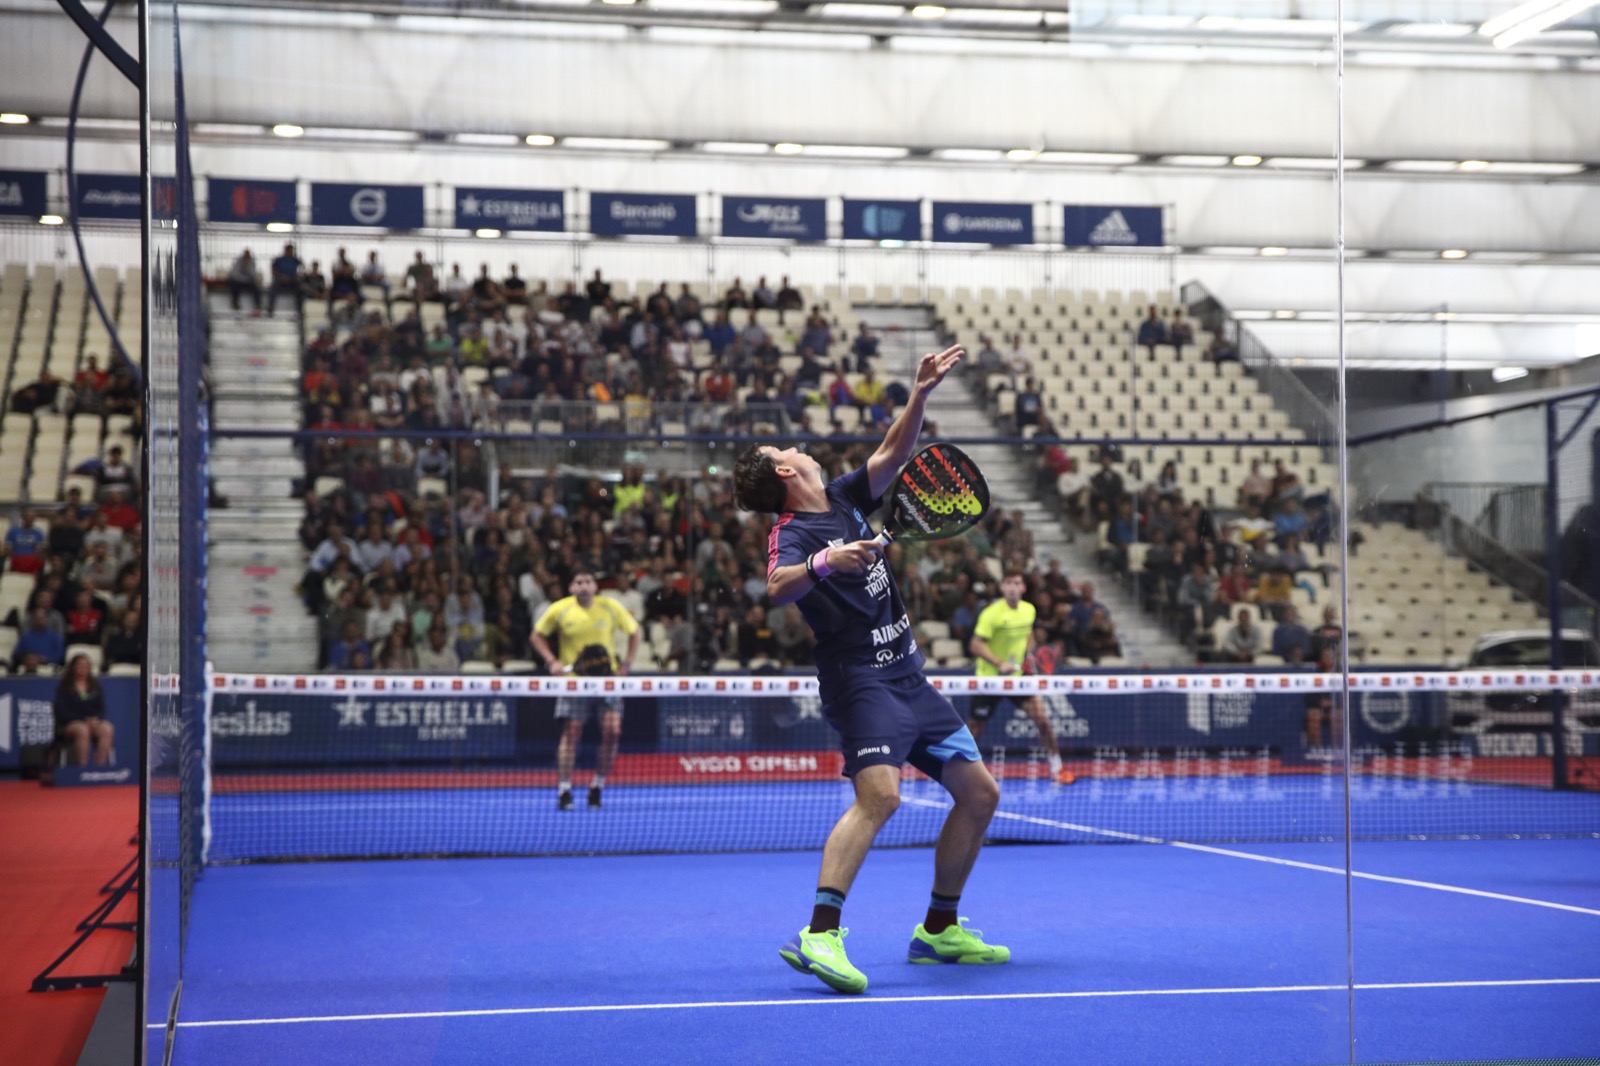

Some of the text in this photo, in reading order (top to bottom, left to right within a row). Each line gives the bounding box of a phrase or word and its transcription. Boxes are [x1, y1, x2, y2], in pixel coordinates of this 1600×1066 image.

[482, 200, 561, 218] ESTRELLA
[898, 493, 935, 534] Bullpadel
[374, 701, 508, 727] ESTRELLA
[857, 746, 880, 758] Allianz
[679, 755, 818, 773] VIGO OPEN
